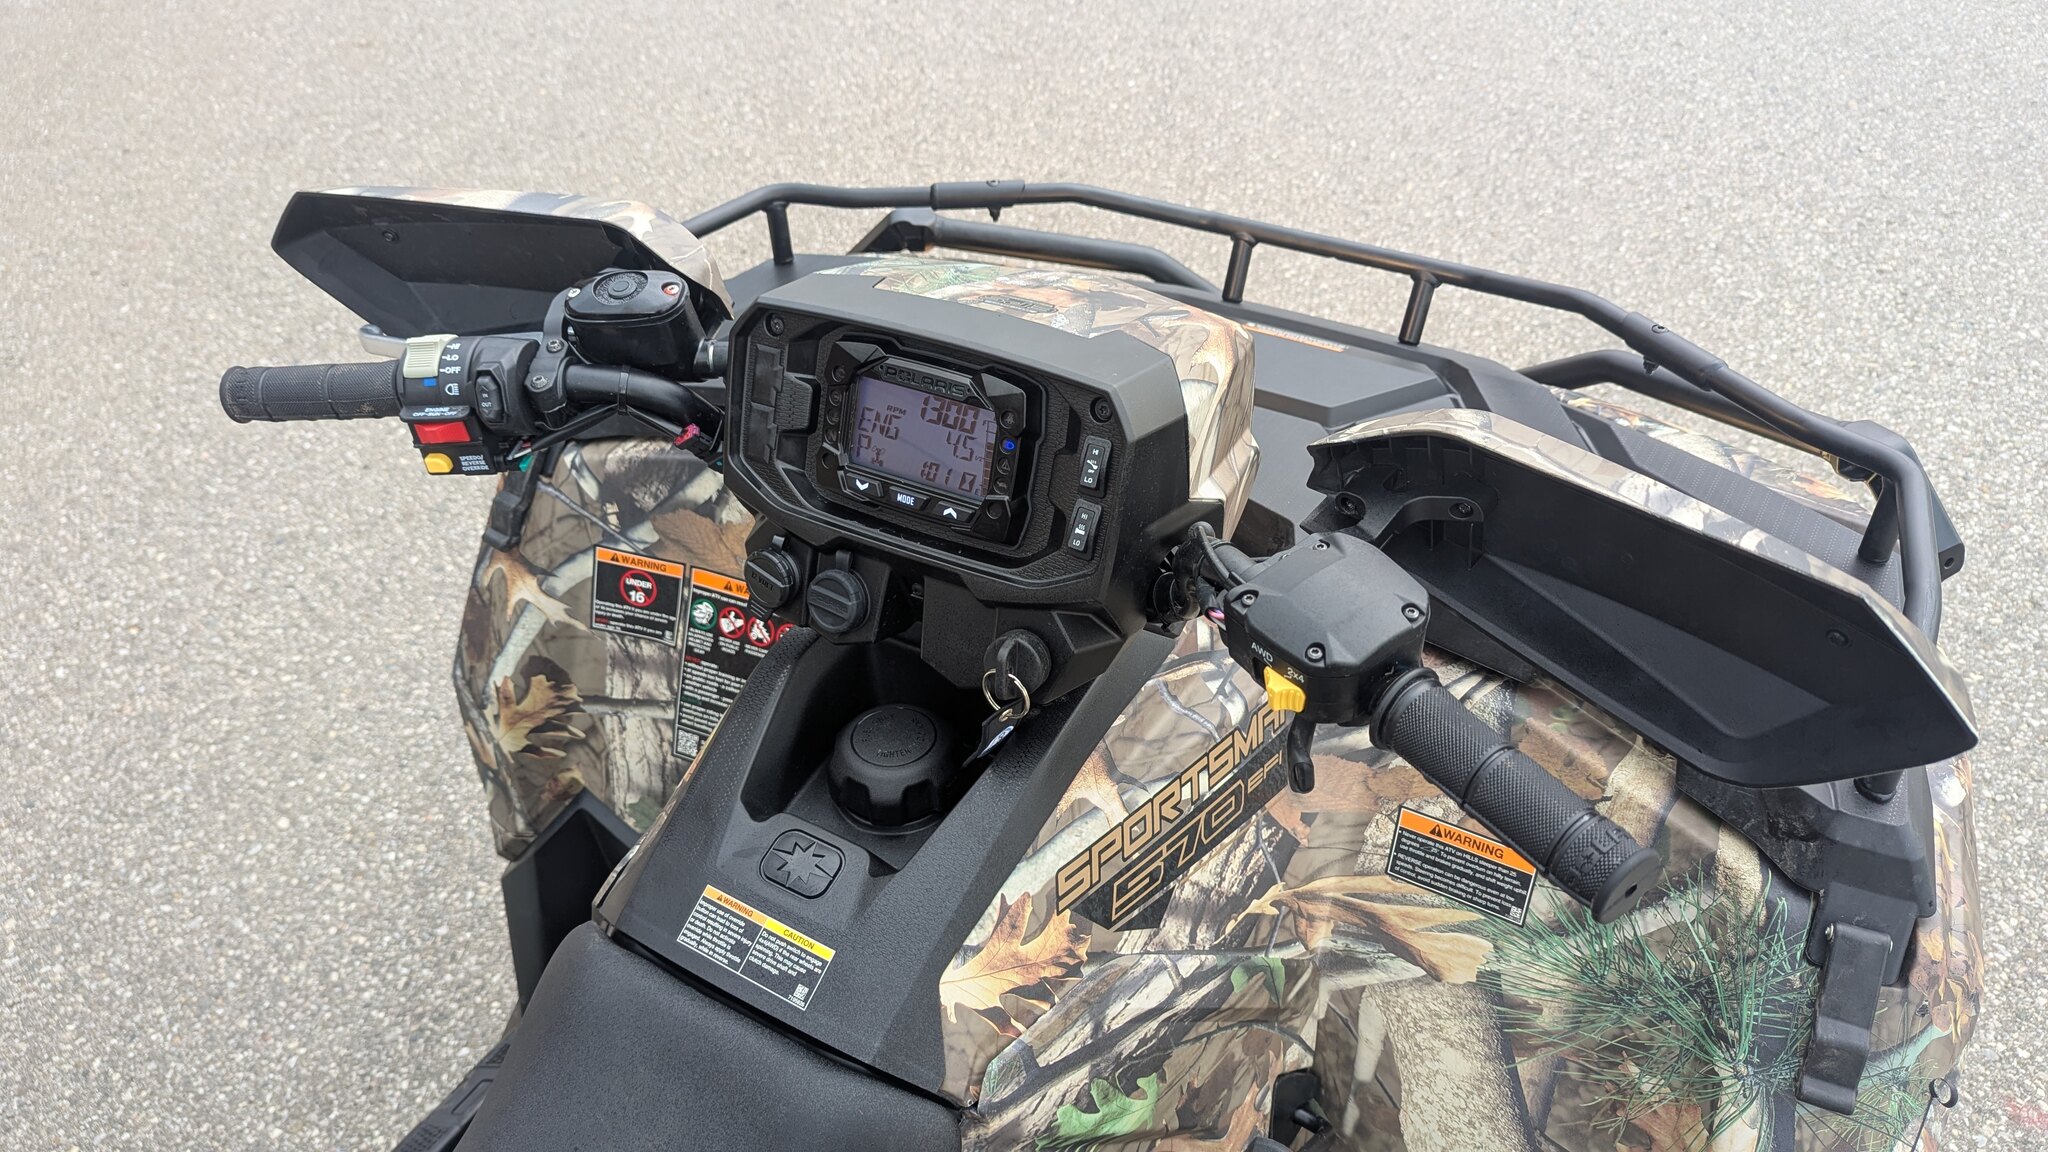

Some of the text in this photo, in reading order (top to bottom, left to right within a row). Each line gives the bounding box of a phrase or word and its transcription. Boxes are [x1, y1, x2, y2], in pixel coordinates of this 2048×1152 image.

[885, 366, 965, 396] POLARIS
[886, 395, 980, 435] RPM 1300
[858, 407, 901, 440] ENG
[1083, 476, 1093, 484] LO
[896, 492, 915, 506] MODE
[1081, 512, 1088, 520] HI
[1072, 538, 1081, 547] LO
[621, 555, 666, 572] WARNING
[625, 576, 652, 589] UNDER
[628, 589, 645, 603] 16
[1251, 642, 1273, 662] AWD
[1287, 667, 1304, 683] 2x4
[1111, 750, 1283, 921] 570 EFI
[1442, 828, 1505, 859] WARNING
[1397, 852, 1421, 866] REVERSE
[1444, 846, 1455, 854] ATV
[1462, 853, 1478, 862] HILLS
[722, 896, 753, 917] WARNING
[782, 928, 815, 949] CAUTION
